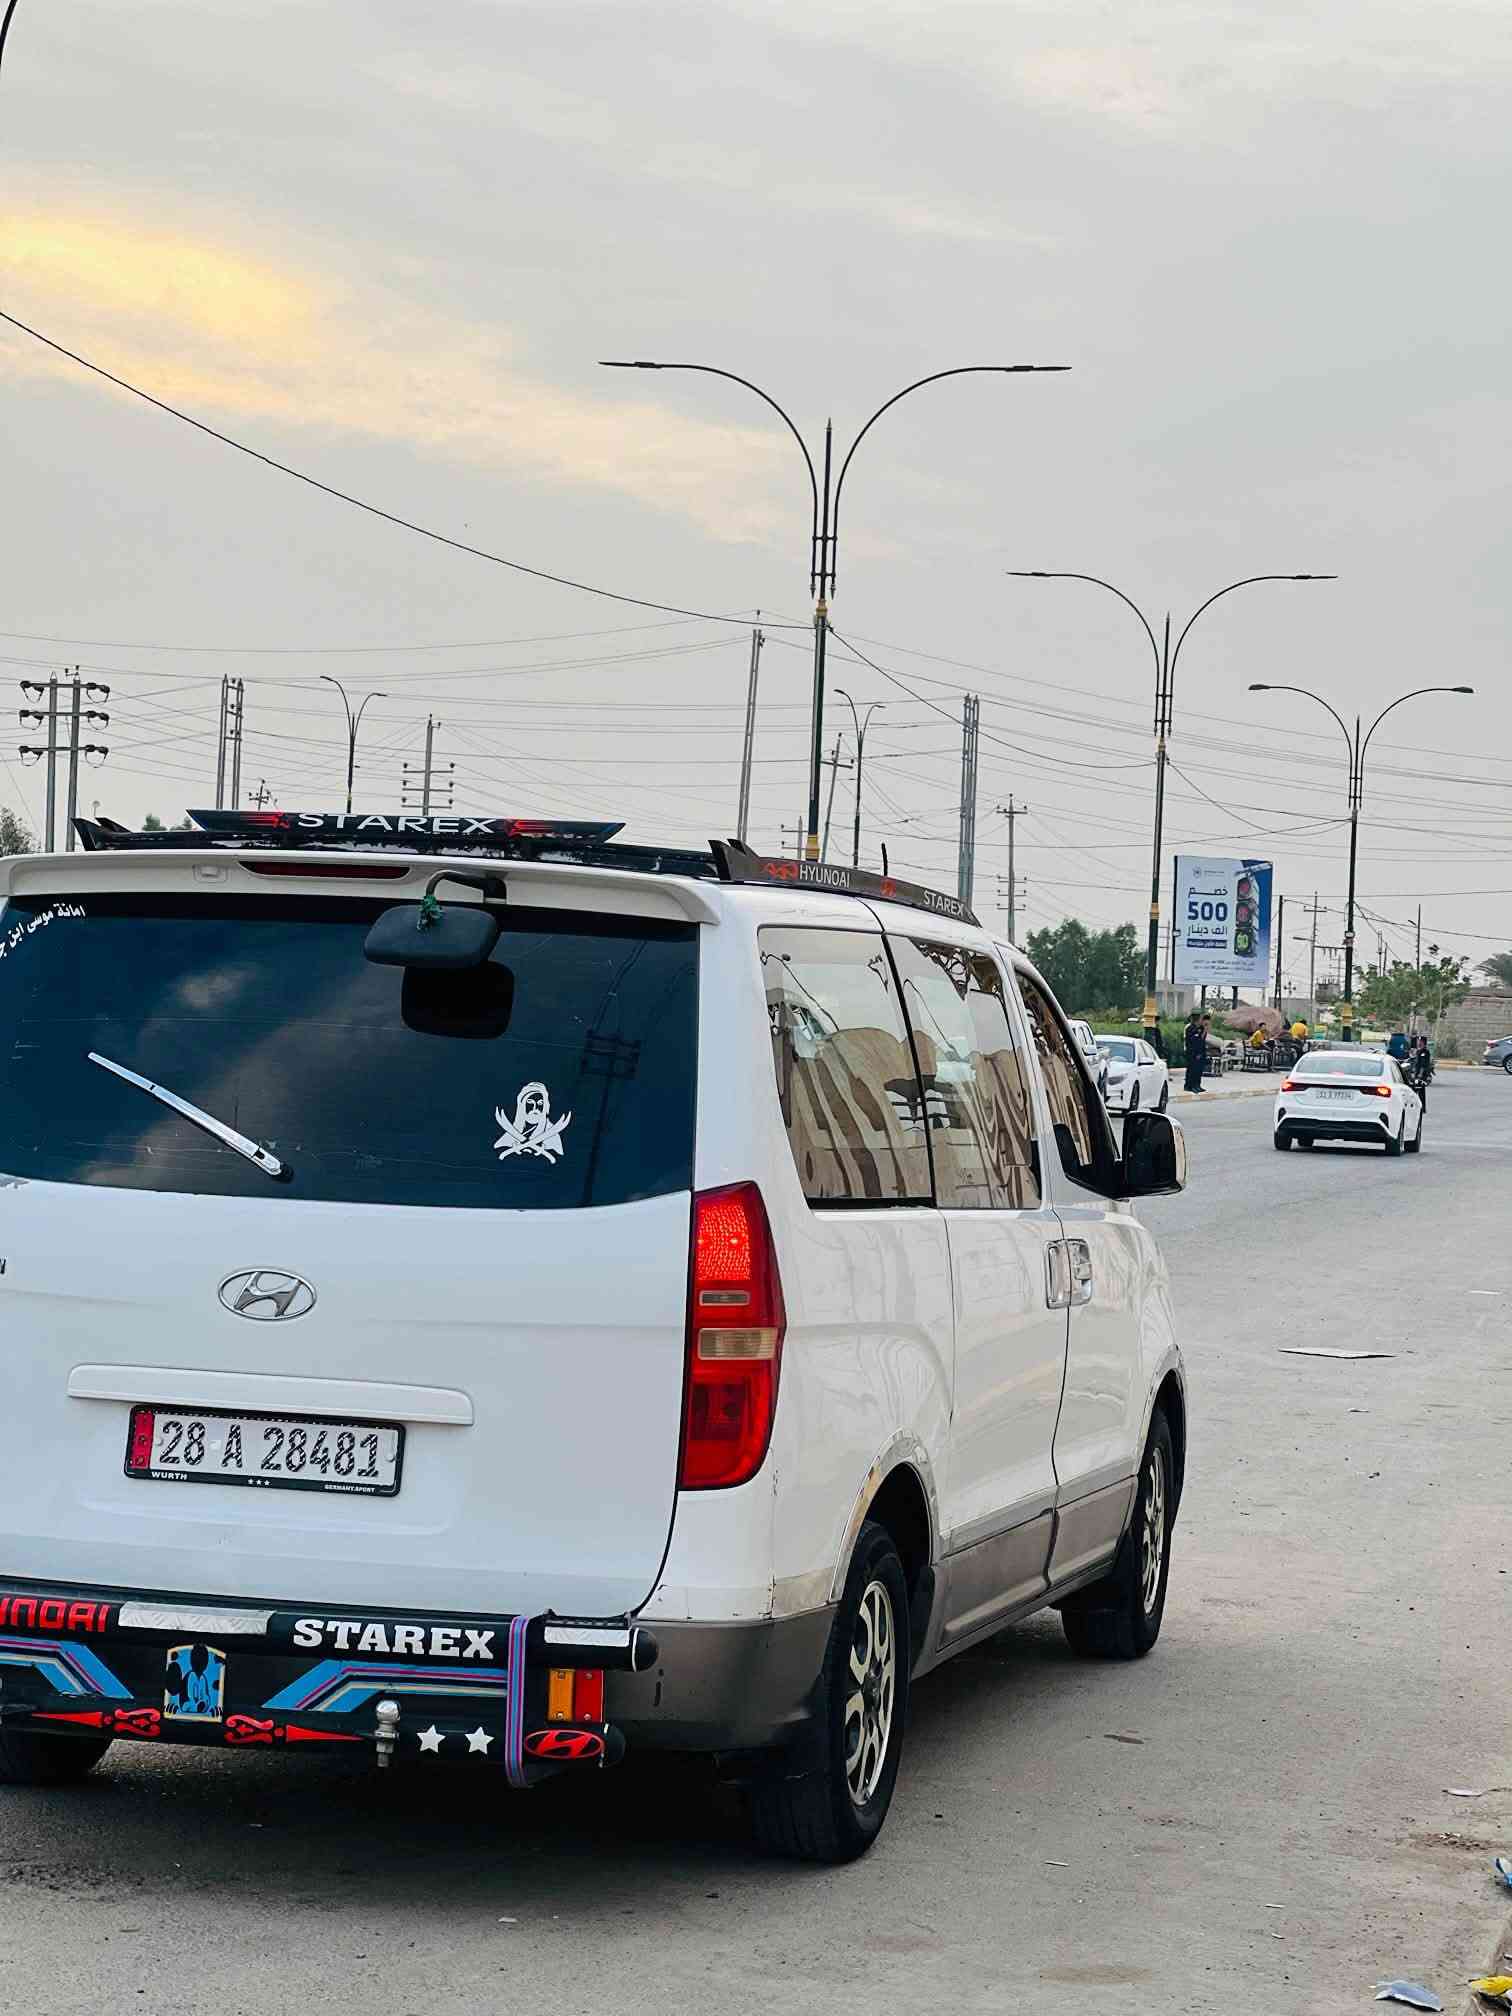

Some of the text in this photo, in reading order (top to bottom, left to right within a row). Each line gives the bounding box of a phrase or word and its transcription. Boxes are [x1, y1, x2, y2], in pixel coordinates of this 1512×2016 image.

[298, 812, 496, 833] STAREX
[923, 890, 964, 917] STAREX
[1187, 901, 1228, 922] 500
[160, 1420, 205, 1465] 28
[222, 1424, 243, 1468] A
[261, 1426, 379, 1478] 28481
[151, 1471, 188, 1481] WURTH
[293, 1619, 495, 1660] STAREX
